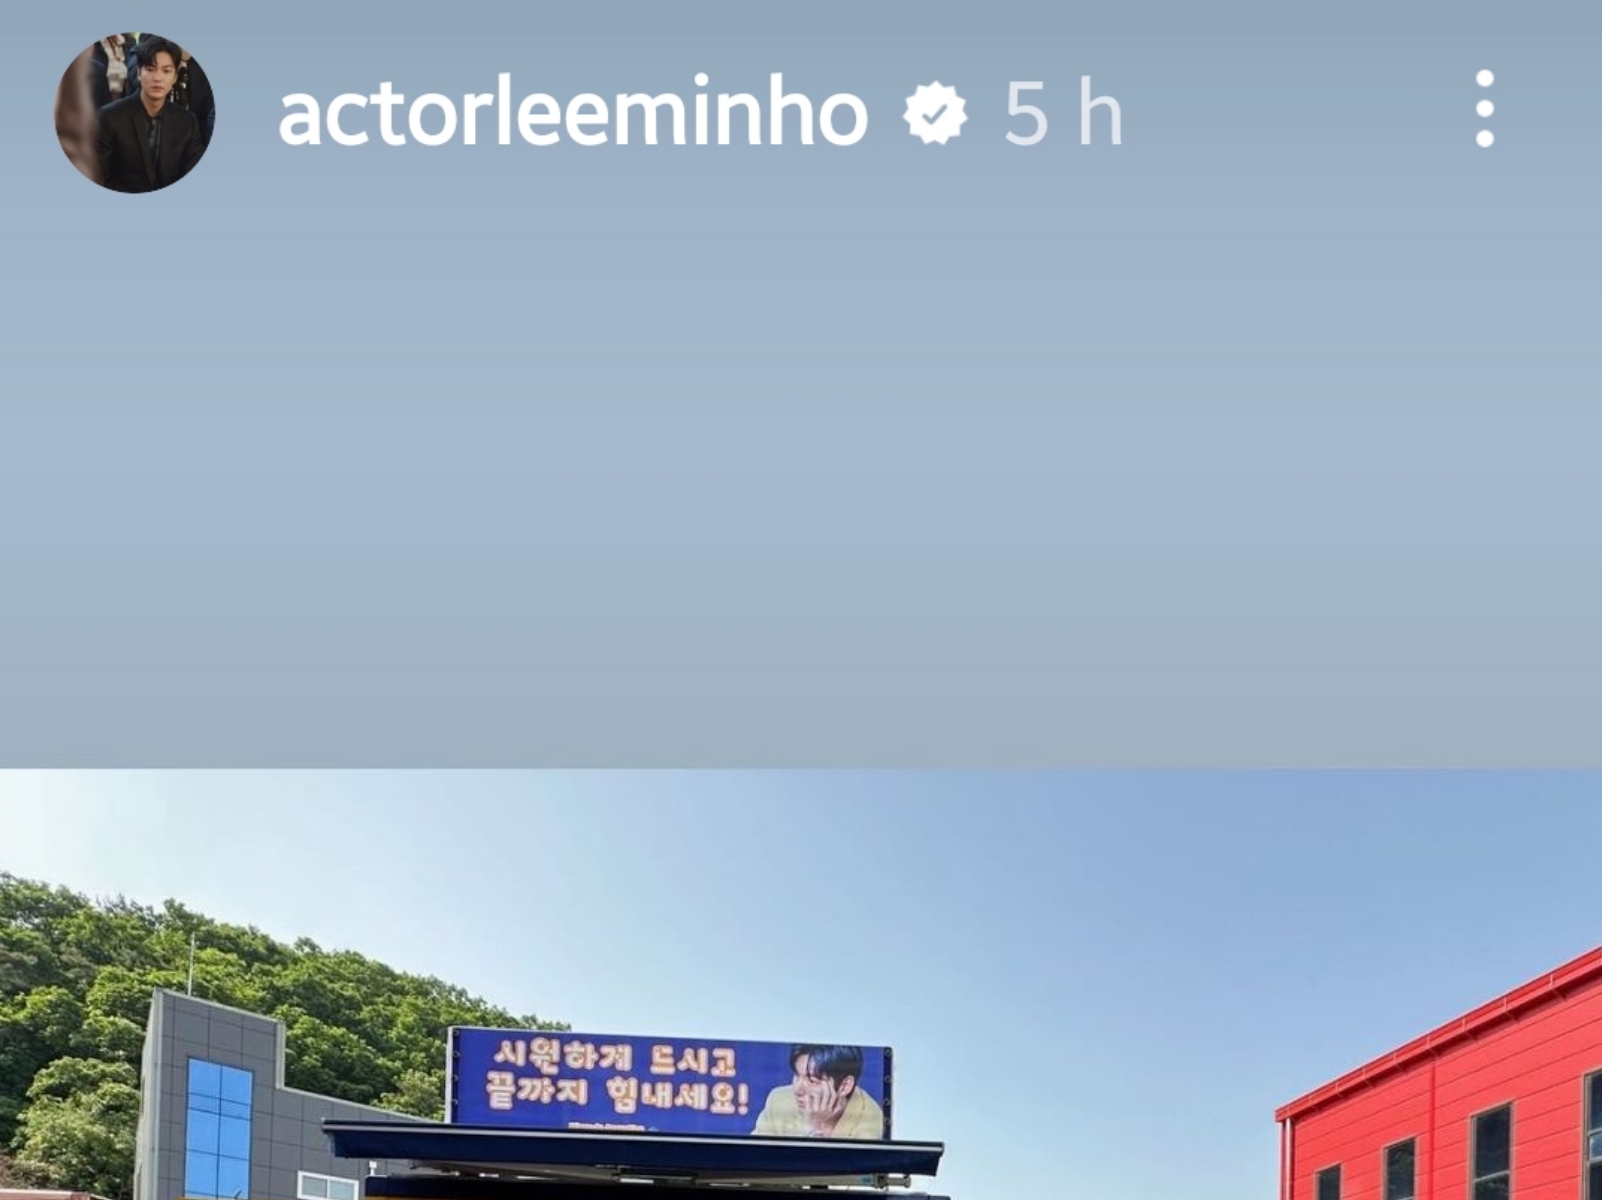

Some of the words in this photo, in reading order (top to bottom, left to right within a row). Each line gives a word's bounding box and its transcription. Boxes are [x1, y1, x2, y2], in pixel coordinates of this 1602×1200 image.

[493, 1037, 634, 1076] 시원하게
[649, 1044, 737, 1078] 드시고
[485, 1069, 588, 1110] 끝까지
[606, 1076, 749, 1115] 힘내세요!
